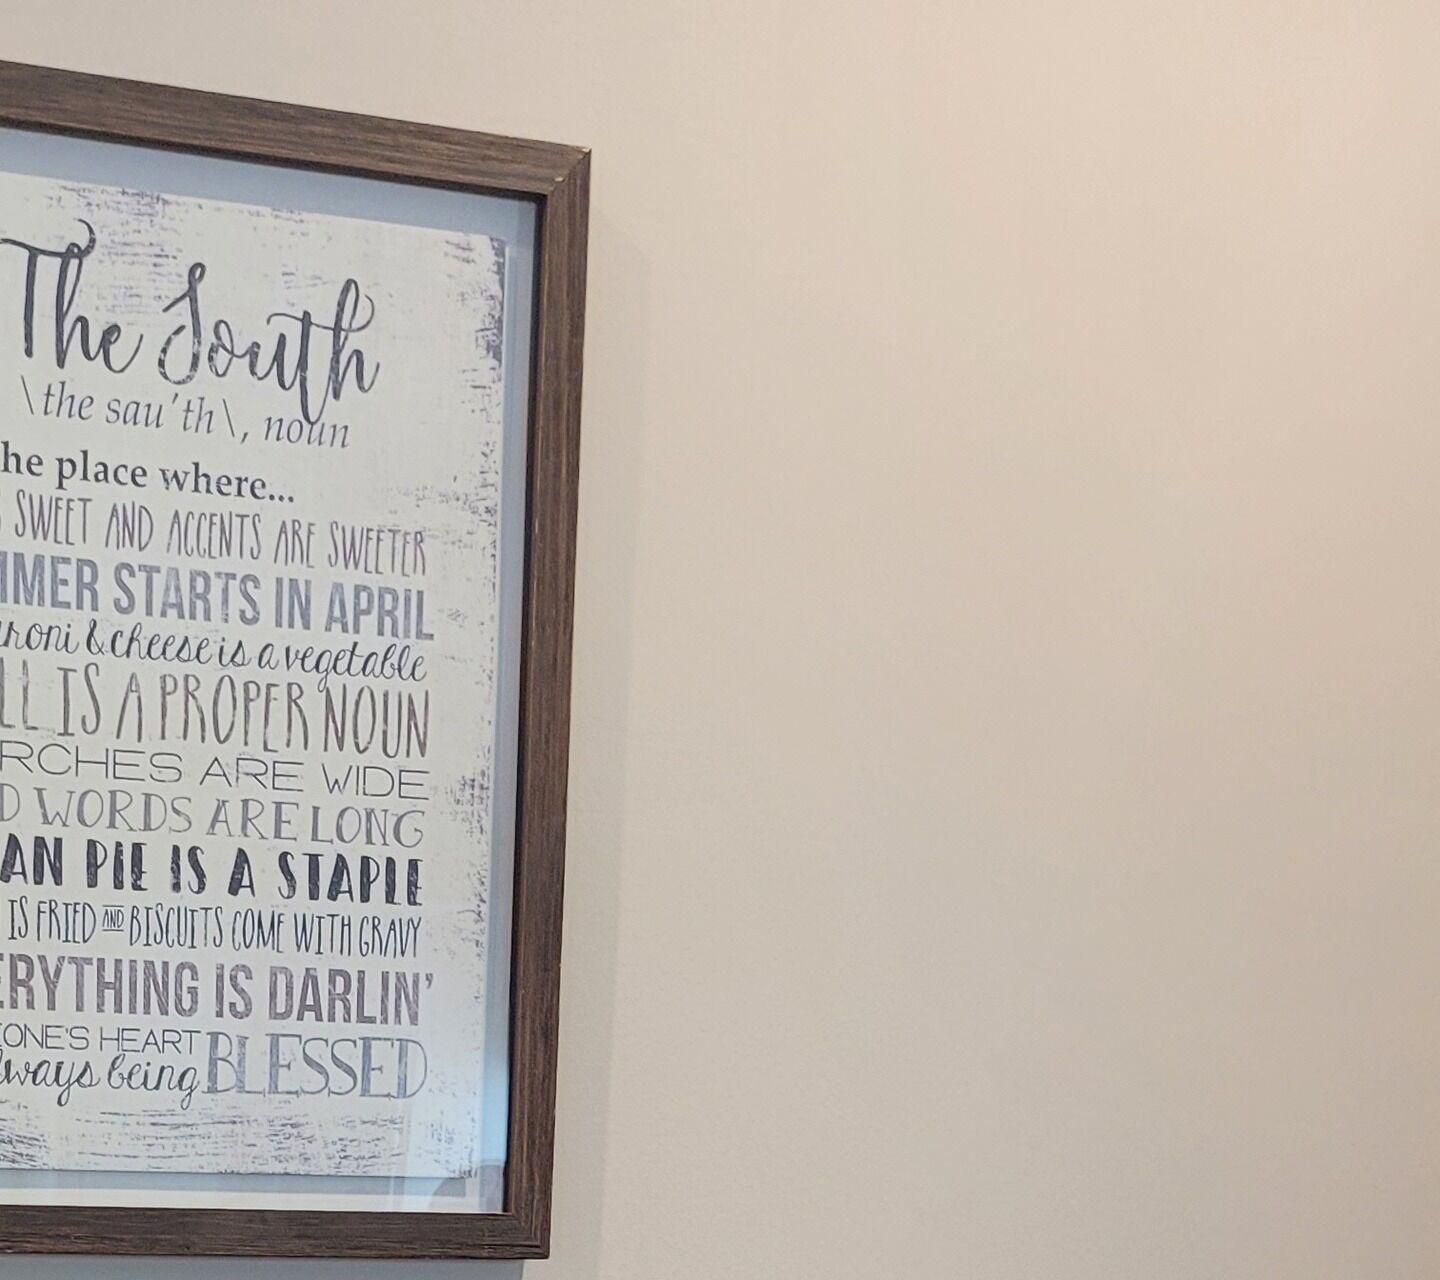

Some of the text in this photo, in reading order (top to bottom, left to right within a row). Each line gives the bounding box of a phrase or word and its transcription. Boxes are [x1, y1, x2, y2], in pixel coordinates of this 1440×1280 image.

[157, 261, 380, 425] South
[263, 415, 351, 449] noun
[55, 449, 149, 491] place
[159, 462, 296, 503] where...
[14, 489, 93, 547] SWEET
[105, 500, 154, 553] AND
[166, 510, 262, 560] ACCENTS
[274, 519, 316, 569] ARE
[328, 520, 427, 577] SWEETER
[113, 561, 261, 627] STARTS
[274, 576, 312, 631] IN
[324, 582, 436, 641] APRIL
[86, 618, 110, 655] &
[110, 622, 214, 666] cheese
[218, 634, 252, 670] is
[257, 644, 280, 671] a
[284, 642, 428, 693] vegetable
[56, 662, 101, 737] IS
[116, 672, 143, 743] A
[159, 673, 309, 753] PROPER
[323, 684, 430, 759] NOUN
[200, 756, 304, 792] ARE
[321, 762, 431, 800] WIDE
[33, 787, 193, 834] WORDS
[205, 798, 300, 842] ARE
[311, 805, 426, 848] LONG
[85, 838, 149, 891] PIE
[170, 844, 207, 896] IS
[227, 847, 256, 897] A
[277, 850, 424, 907] STAPLE
[8, 898, 28, 941] IS
[36, 899, 97, 945] FRIED
[101, 904, 125, 932] AND
[129, 903, 224, 949] BISCUITS
[232, 910, 284, 955] COME
[293, 912, 353, 957] WITH
[358, 914, 422, 959] GRAVY
[215, 962, 253, 1020] IS
[268, 968, 435, 1026] DARLIN'
[99, 1027, 201, 1055] HEART
[107, 1055, 201, 1111] being
[204, 1031, 428, 1099] BLESSED
